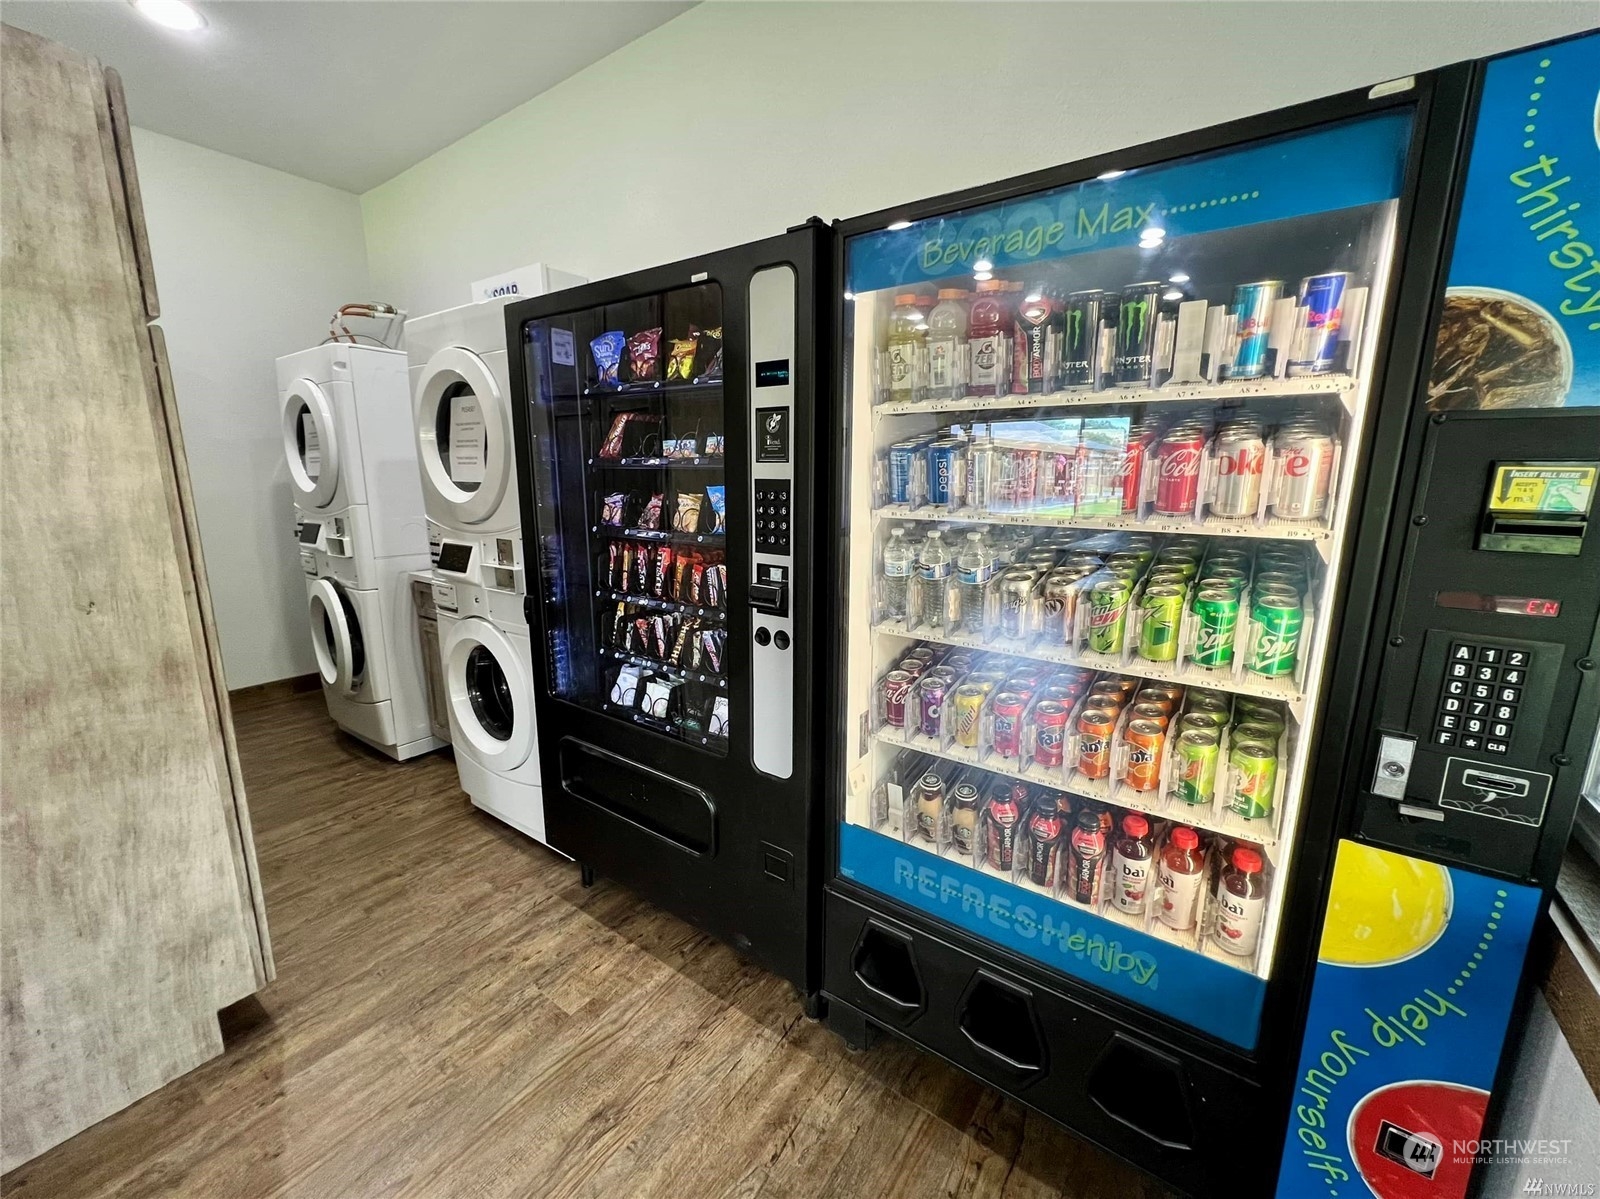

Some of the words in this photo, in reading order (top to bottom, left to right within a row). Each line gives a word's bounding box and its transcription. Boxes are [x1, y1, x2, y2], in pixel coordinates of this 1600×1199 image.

[922, 220, 1065, 268] Beverage
[1077, 200, 1157, 240] Max
[974, 354, 993, 365] ZER
[1115, 355, 1152, 366] ONSTER
[1219, 448, 1264, 476] oke
[938, 457, 948, 493] pepsi
[1510, 469, 1540, 478] INSERT
[1540, 470, 1557, 478] BILL
[1559, 471, 1582, 479] HERE
[1456, 647, 1469, 659] A
[1486, 650, 1496, 662] 1
[1510, 653, 1523, 665] 2
[1453, 665, 1466, 677] B
[1480, 668, 1492, 679] 3
[1506, 671, 1519, 683] 4
[1450, 682, 1463, 694] C
[1476, 685, 1488, 697] 5
[1502, 689, 1515, 701] 6
[1446, 699, 1459, 711] D
[1473, 703, 1485, 715] 7
[1499, 707, 1511, 719] 8
[1443, 716, 1455, 728] E
[1469, 720, 1481, 732] 9
[1495, 724, 1507, 736] 0
[1038, 729, 1064, 746] Fan
[1080, 739, 1110, 753] anta
[1440, 733, 1452, 744] F
[1487, 742, 1507, 753] CLR
[1129, 750, 1153, 762] nta
[1122, 863, 1145, 878] bai
[1221, 894, 1244, 916] bai
[1067, 932, 1157, 985] enjoy
[1364, 988, 1468, 1048] help
[1296, 1029, 1370, 1182] yourself
